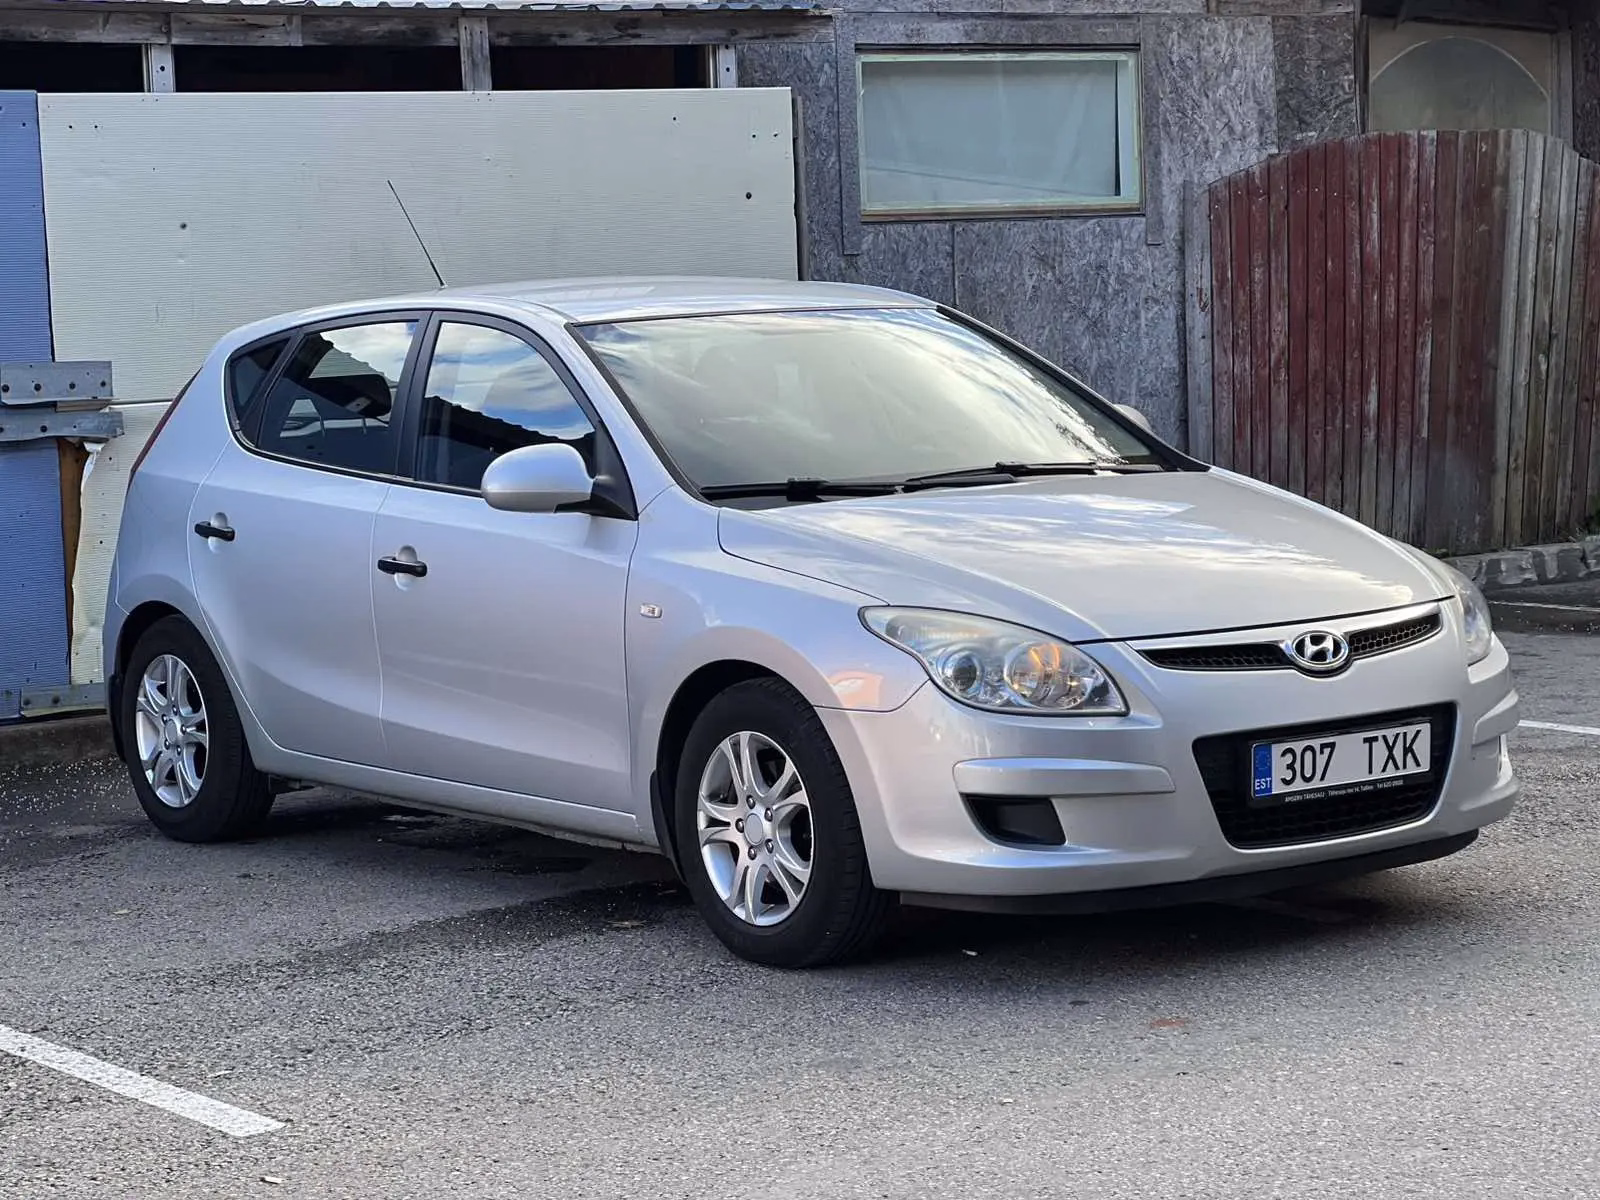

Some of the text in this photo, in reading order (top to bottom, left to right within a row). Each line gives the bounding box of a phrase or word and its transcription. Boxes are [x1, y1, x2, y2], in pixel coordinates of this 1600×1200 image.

[1280, 729, 1421, 786] 307 TXK
[1255, 777, 1272, 790] EST
